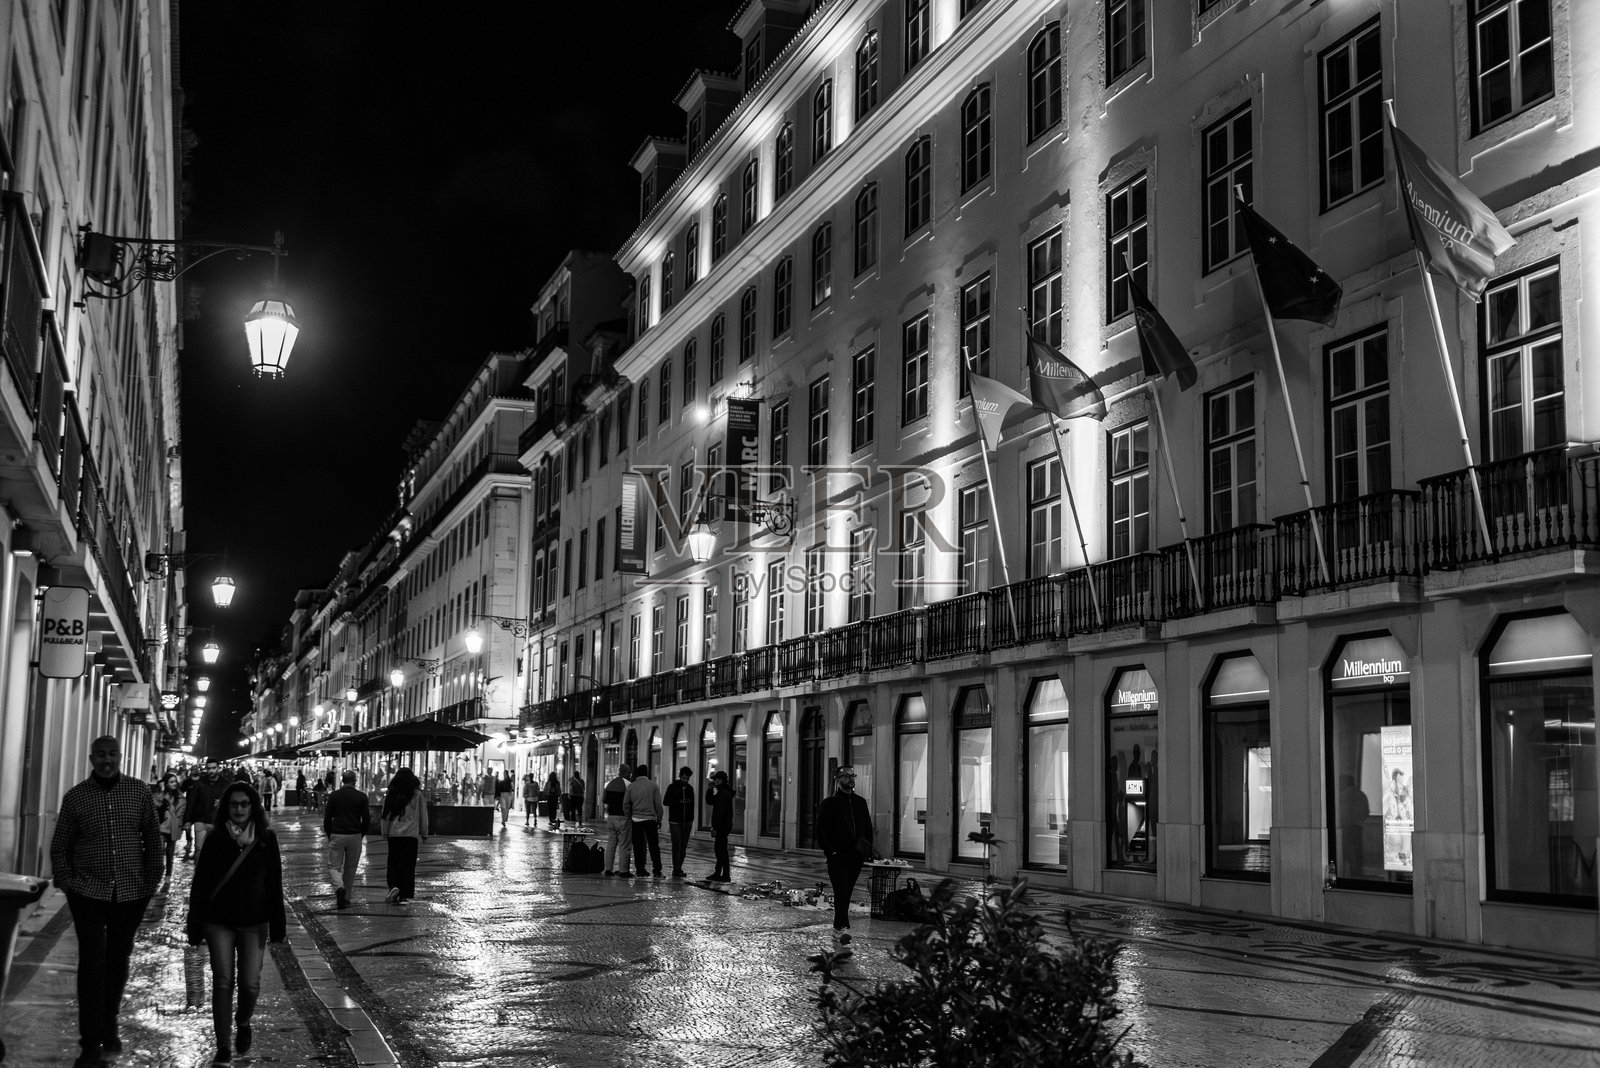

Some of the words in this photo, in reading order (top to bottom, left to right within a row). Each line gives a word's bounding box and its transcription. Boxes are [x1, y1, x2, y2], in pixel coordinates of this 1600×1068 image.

[741, 436, 758, 491] NARC
[44, 618, 84, 636] P&B
[1343, 658, 1402, 677] Millennium
[1383, 674, 1395, 684] bcp
[1118, 689, 1156, 704] Millennium
